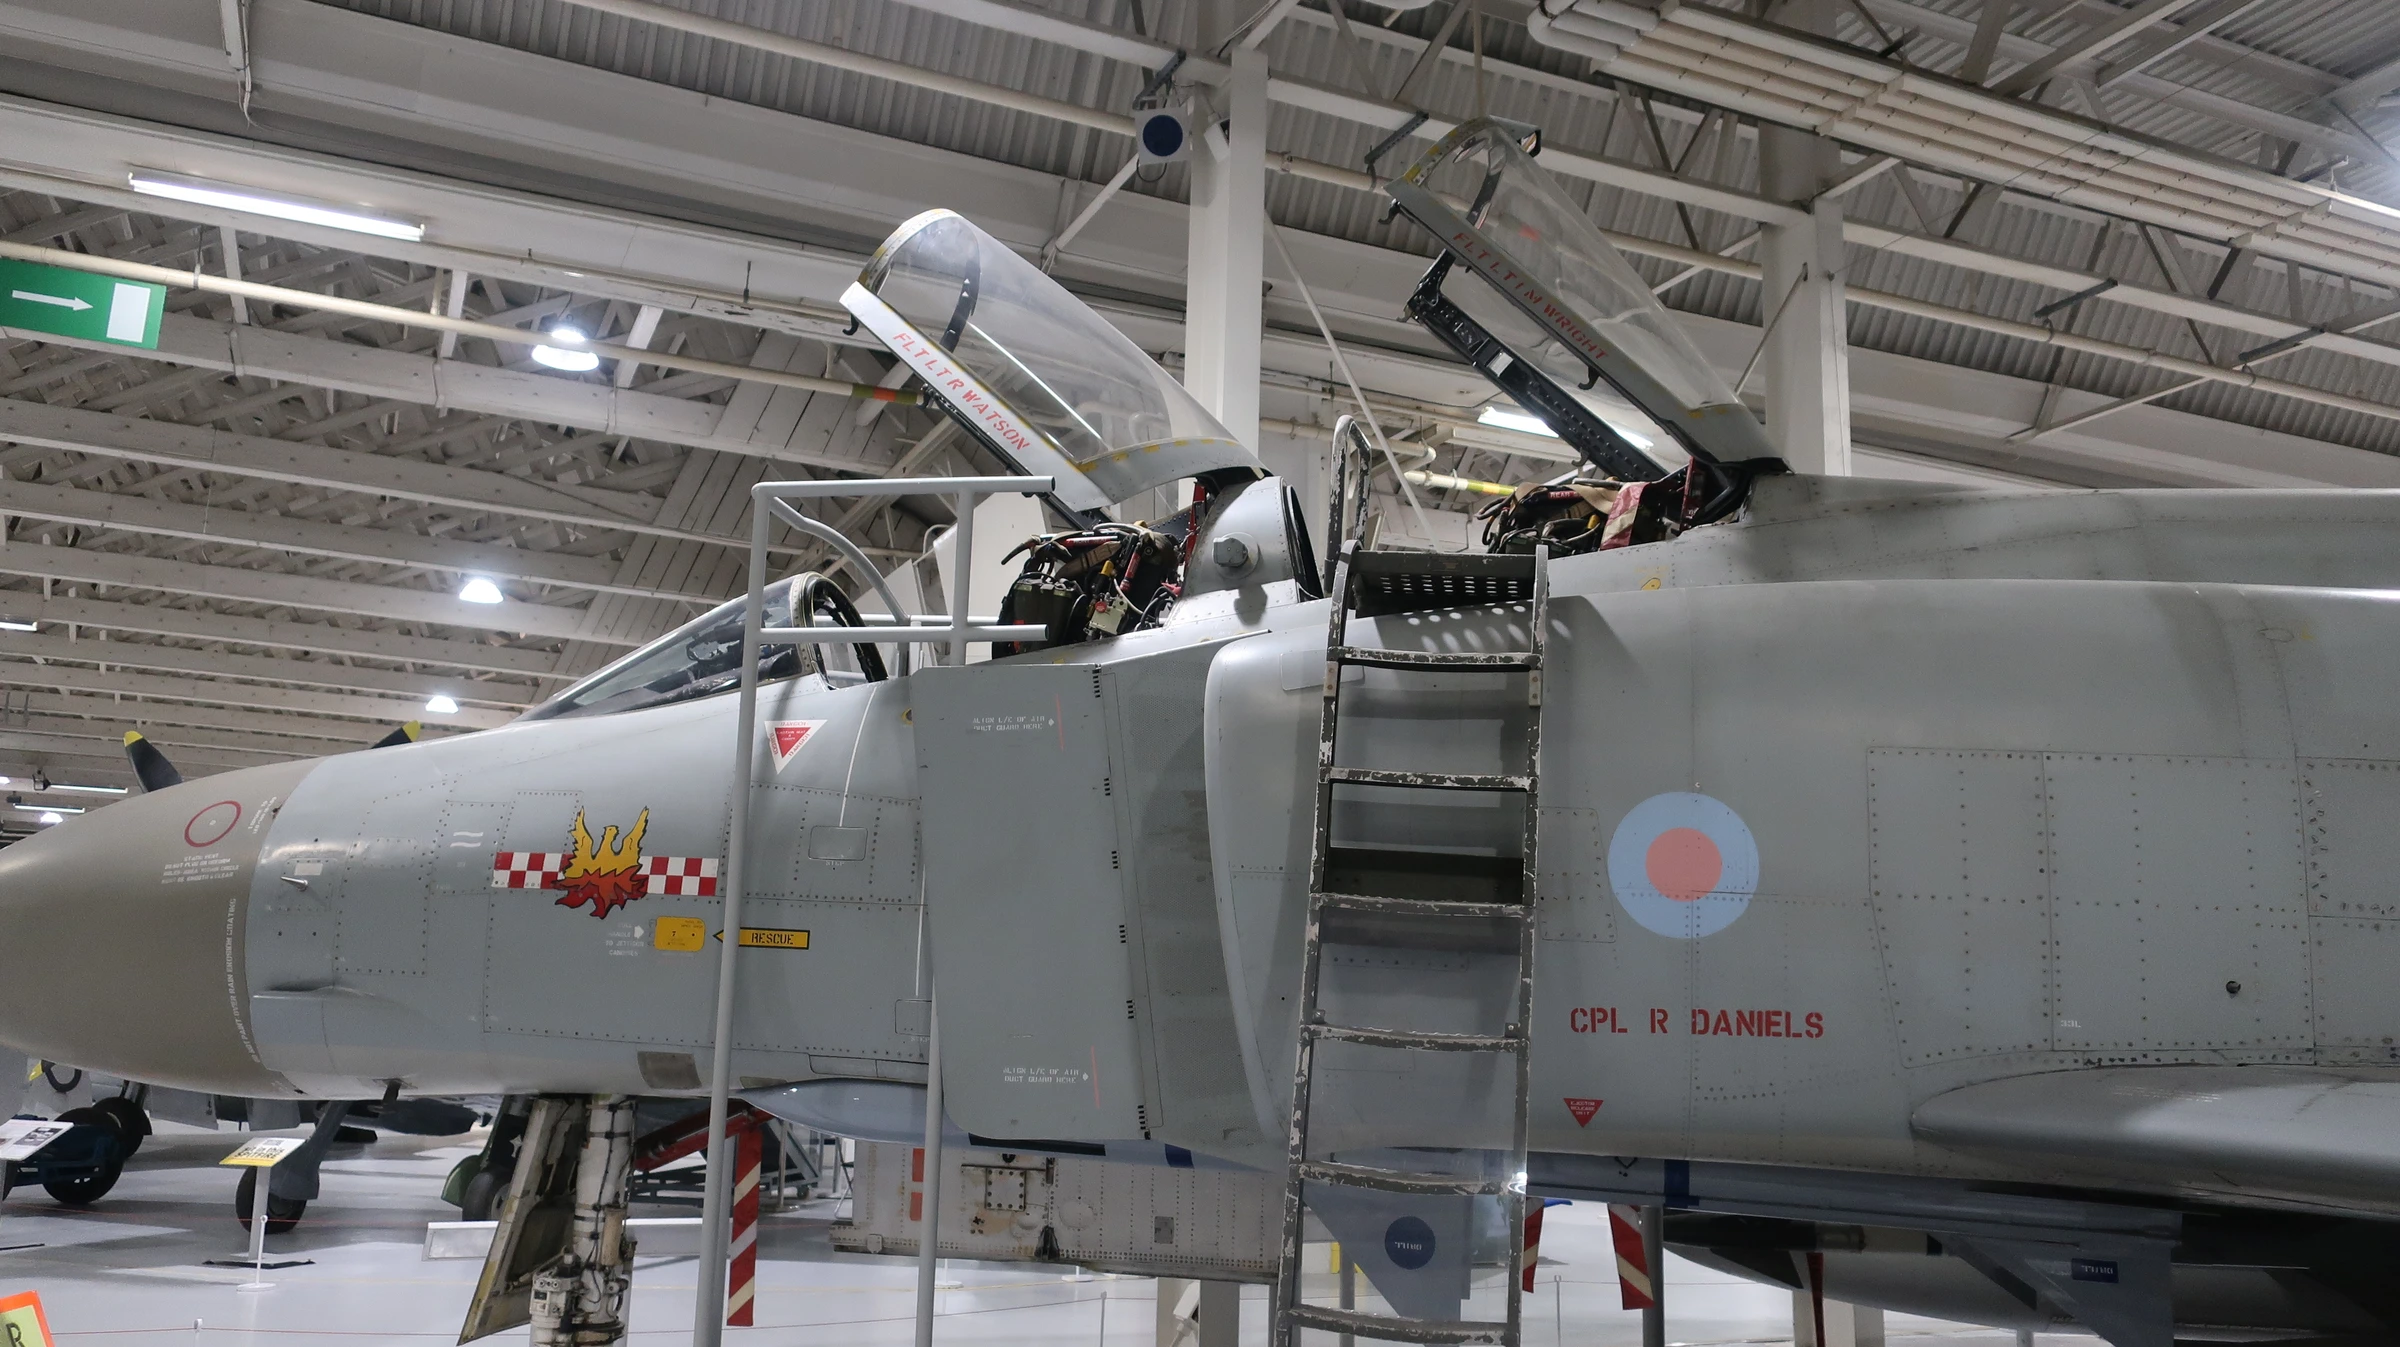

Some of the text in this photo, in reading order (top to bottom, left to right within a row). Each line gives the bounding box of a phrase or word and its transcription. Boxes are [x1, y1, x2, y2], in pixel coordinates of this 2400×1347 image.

[1453, 232, 1491, 260] FLT
[1543, 303, 1609, 359] WRIGHT
[893, 332, 1031, 451] FLT LT R WATSON
[750, 932, 795, 946] RESCUE
[1570, 1007, 1824, 1038] CPL R DANIELS
[5, 1322, 26, 1347] R
